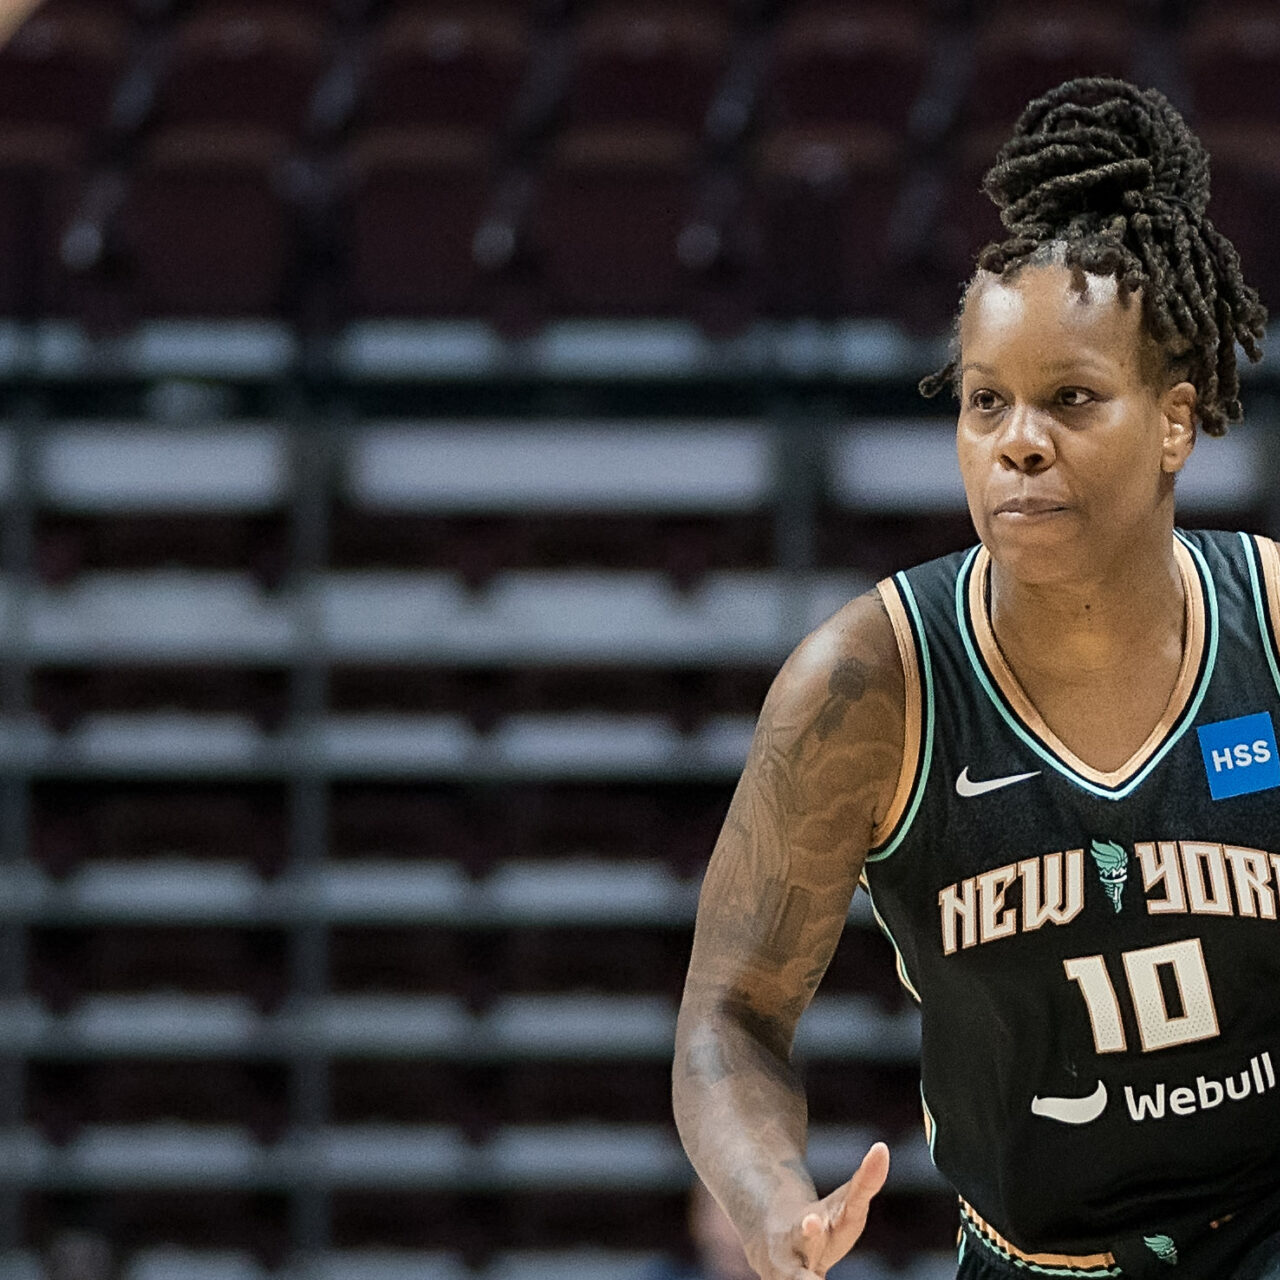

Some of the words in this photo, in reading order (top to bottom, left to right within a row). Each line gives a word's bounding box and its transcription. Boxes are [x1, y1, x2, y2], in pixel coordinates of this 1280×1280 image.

[1211, 740, 1271, 774] HSS
[938, 848, 1084, 956] NEW
[1063, 937, 1220, 1054] 10
[1123, 1052, 1276, 1122] Webull
